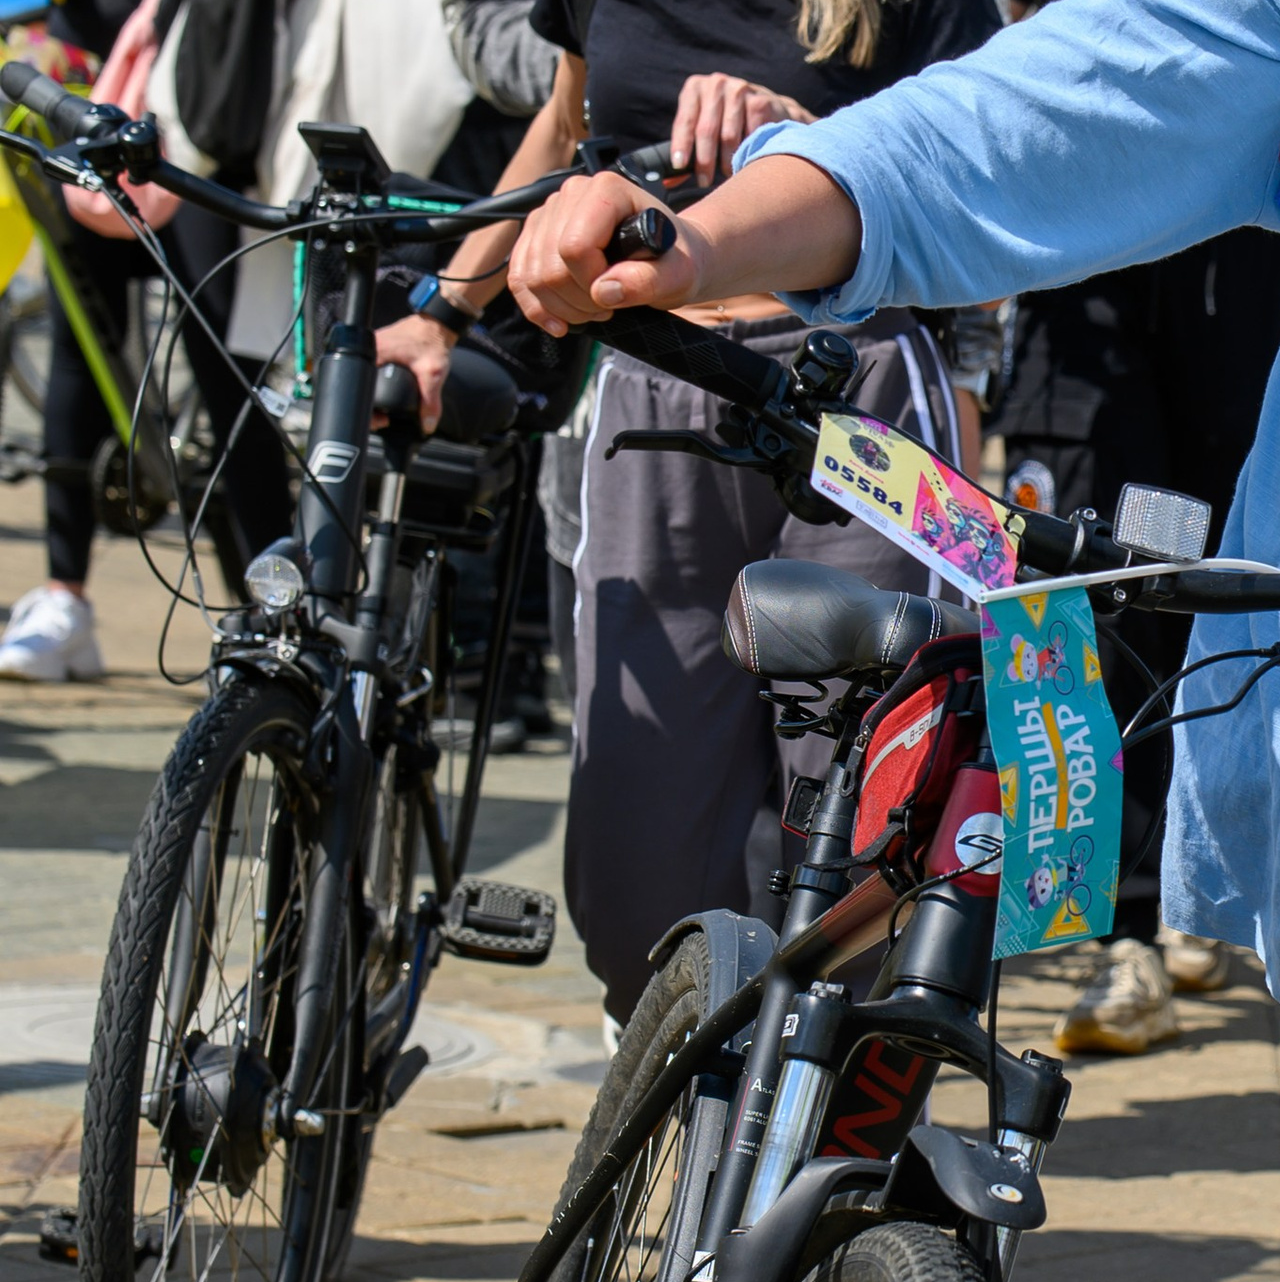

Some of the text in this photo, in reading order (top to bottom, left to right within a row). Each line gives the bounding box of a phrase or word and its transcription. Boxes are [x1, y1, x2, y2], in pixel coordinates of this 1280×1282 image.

[824, 455, 903, 516] 05584
[1013, 696, 1058, 854] ПЕРШЫ
[1055, 703, 1098, 833] РОВАР
